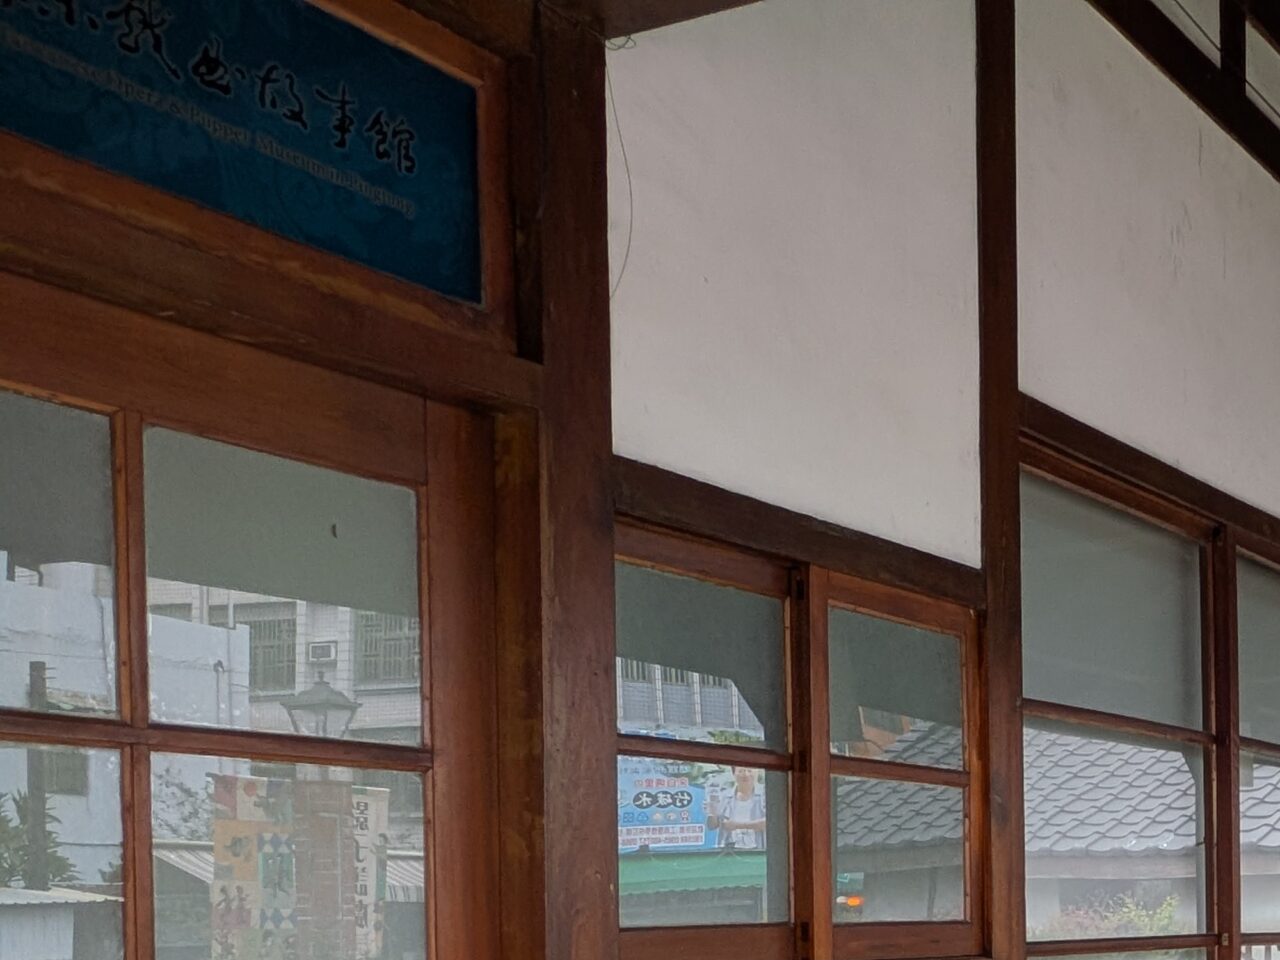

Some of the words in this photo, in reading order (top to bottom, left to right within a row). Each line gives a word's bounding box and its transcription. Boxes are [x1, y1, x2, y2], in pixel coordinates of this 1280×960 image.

[0, 0, 418, 176] 戲曲故事館
